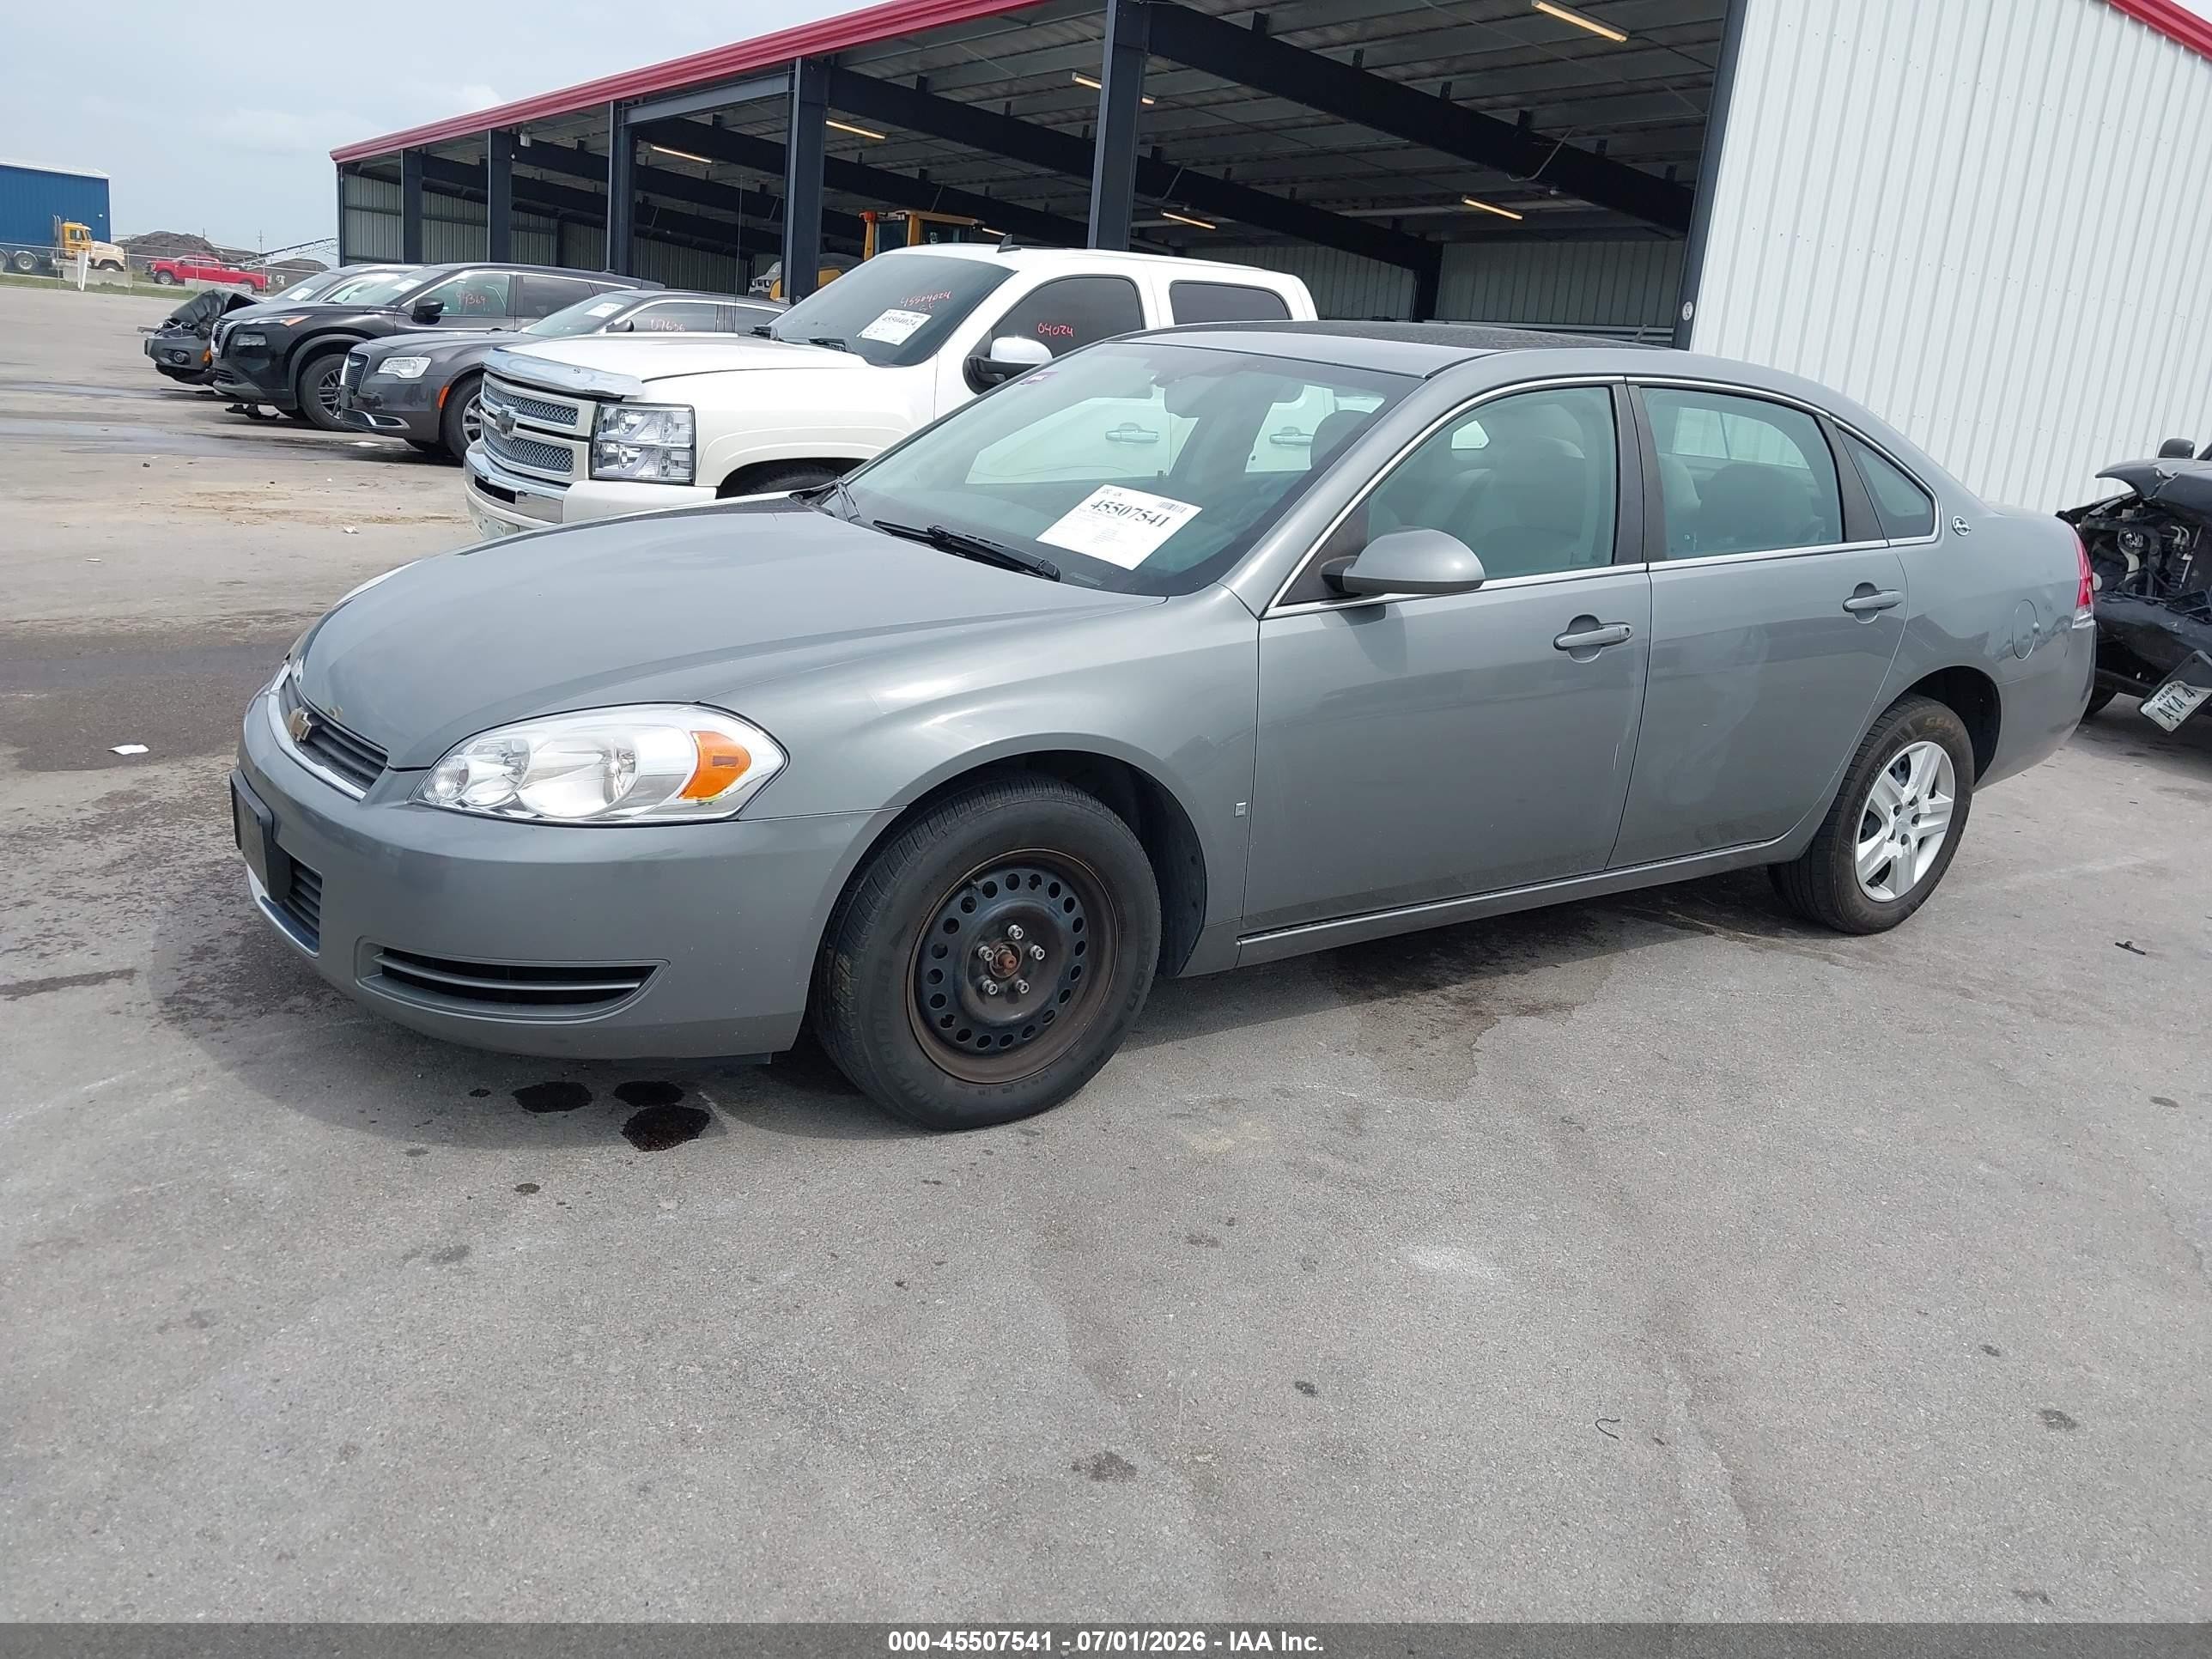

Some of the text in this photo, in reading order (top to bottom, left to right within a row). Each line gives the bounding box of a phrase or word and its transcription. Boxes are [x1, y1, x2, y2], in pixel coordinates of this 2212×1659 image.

[1038, 322, 1073, 337] 04024
[1091, 500, 1170, 527] 45507541
[2157, 696, 2186, 720] AYA
